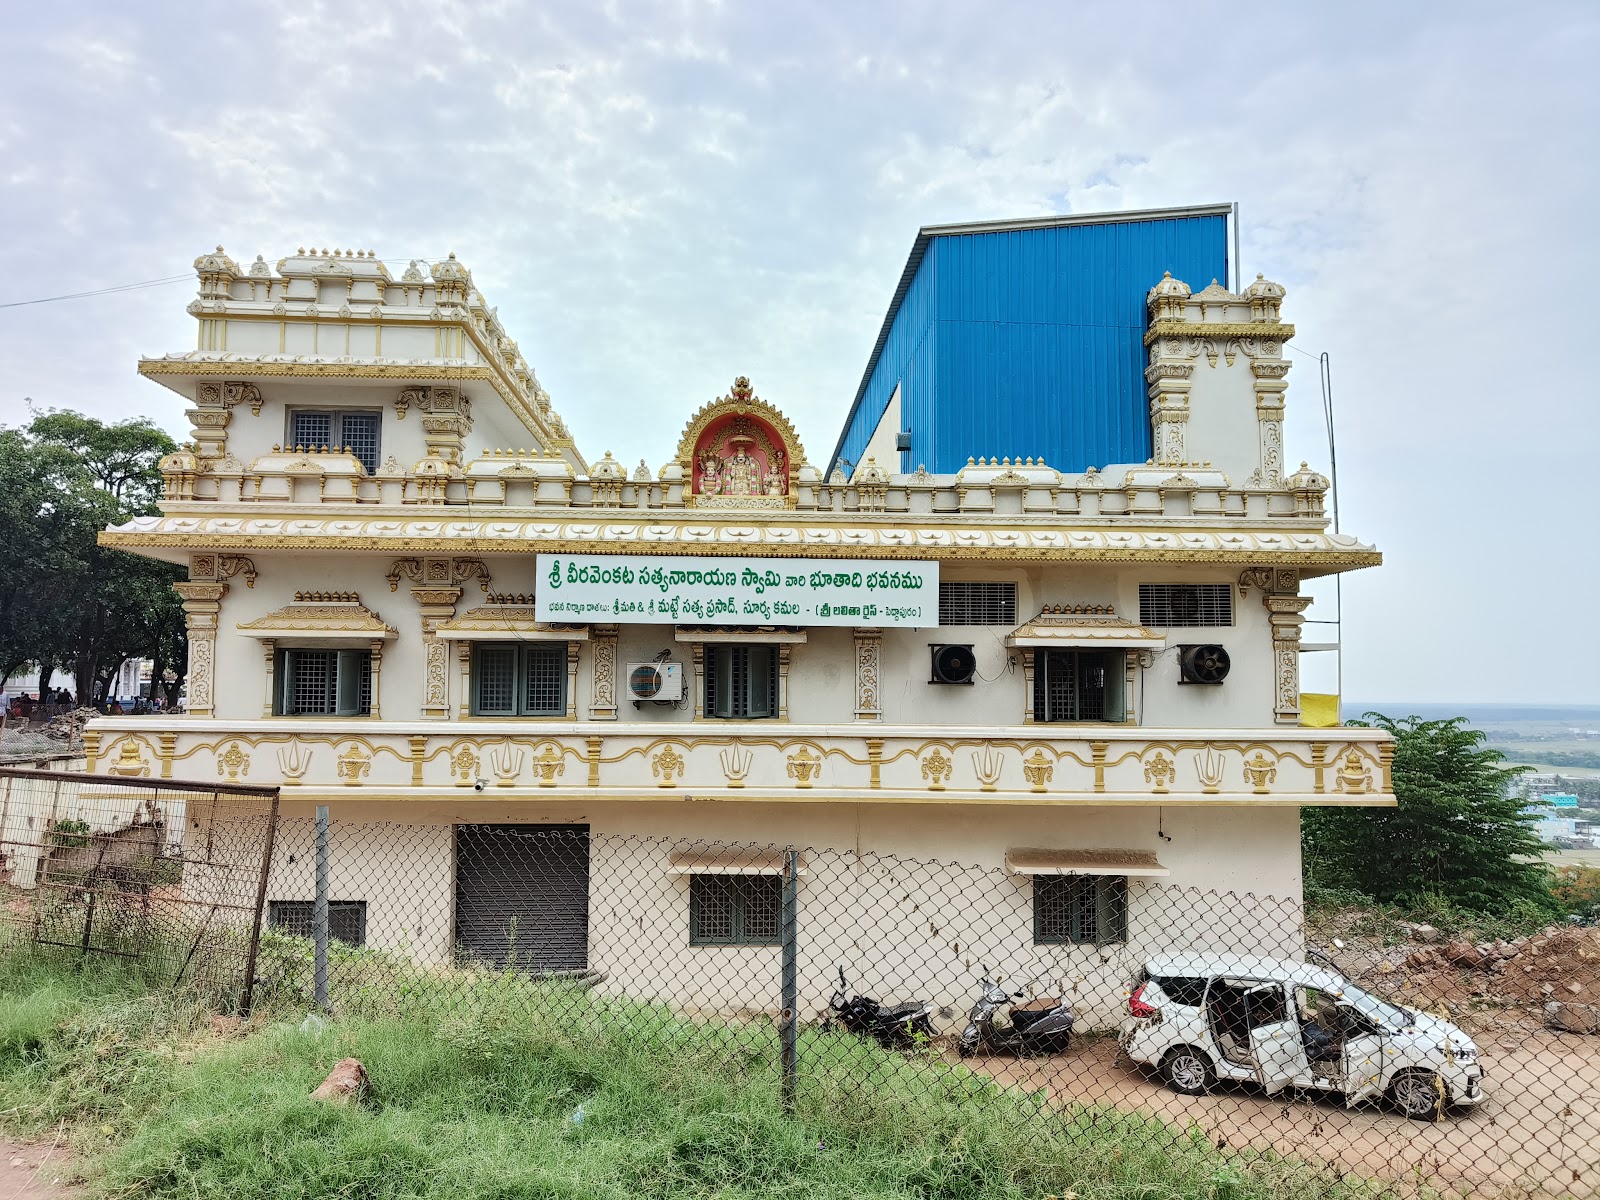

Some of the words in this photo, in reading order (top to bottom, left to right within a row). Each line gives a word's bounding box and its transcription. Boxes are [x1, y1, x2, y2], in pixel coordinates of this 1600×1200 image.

[548, 560, 562, 589] శ్రీ
[567, 562, 634, 584] వీరవెంకట
[639, 566, 736, 592] సత్యనారాయణ
[742, 568, 781, 594] స్వామి
[786, 575, 806, 587] వారి
[810, 571, 862, 590] భూతాది
[867, 571, 922, 591] భవనము
[638, 603, 645, 612] &
[682, 599, 703, 618] సత్య
[743, 600, 771, 620] సూర్య
[774, 602, 800, 615] కమల
